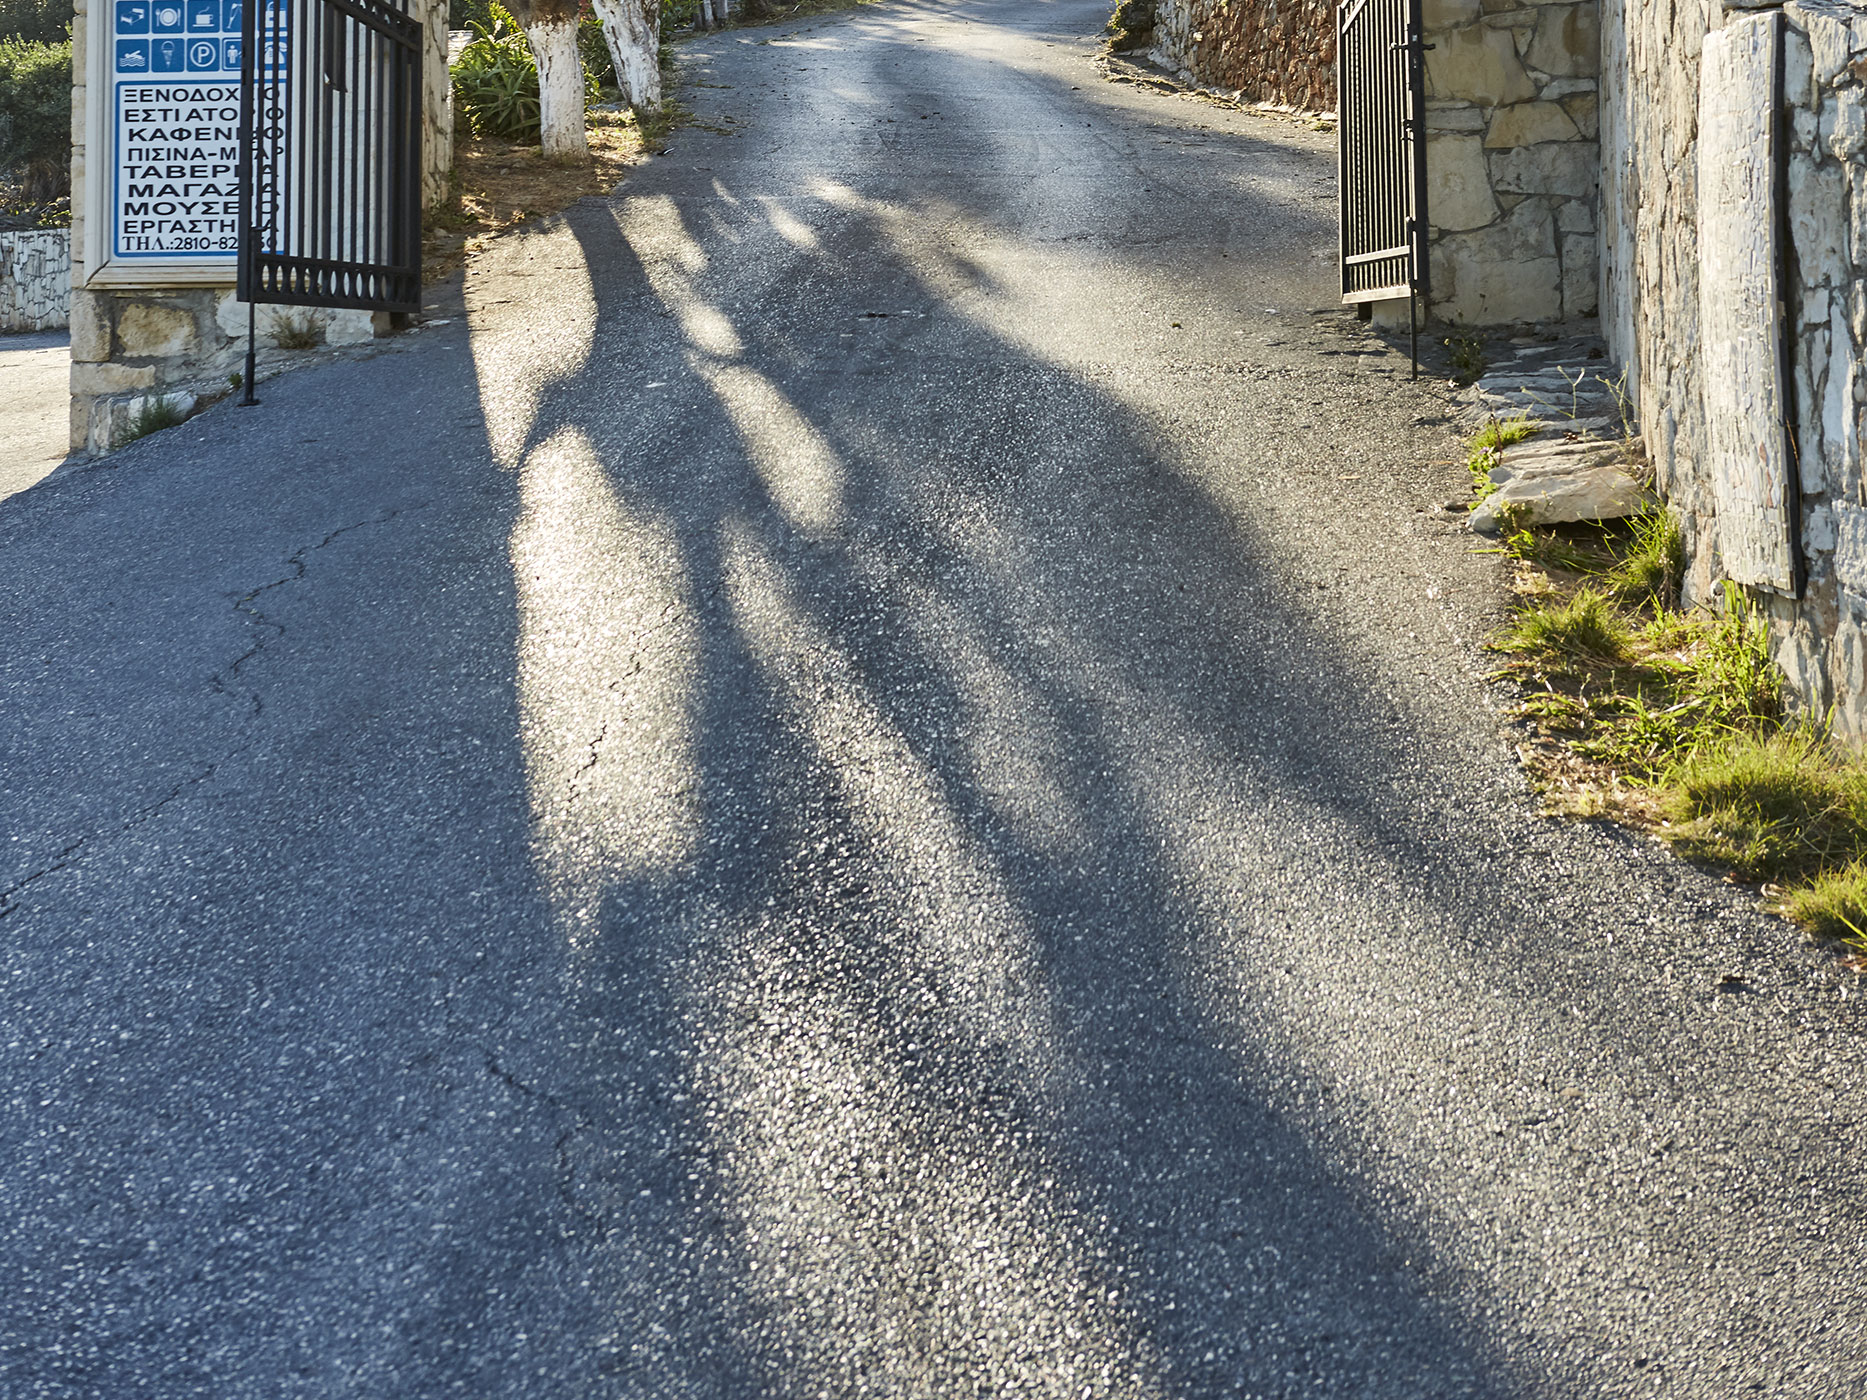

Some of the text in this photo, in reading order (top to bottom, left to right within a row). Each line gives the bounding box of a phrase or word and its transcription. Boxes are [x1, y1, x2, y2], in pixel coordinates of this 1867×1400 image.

[124, 87, 280, 103] ΞΕΝΟΔΟΧΟ
[124, 107, 284, 122] ΕΣΤΙΑΤΟΟ
[128, 126, 284, 142] ΚΑΦΕΝΟ
[123, 164, 279, 179] ΤΑΒΕΡΑ
[128, 183, 281, 198] ΜΑΓΑΖΑ
[124, 201, 279, 216] ΜΟΥΣΕΟ
